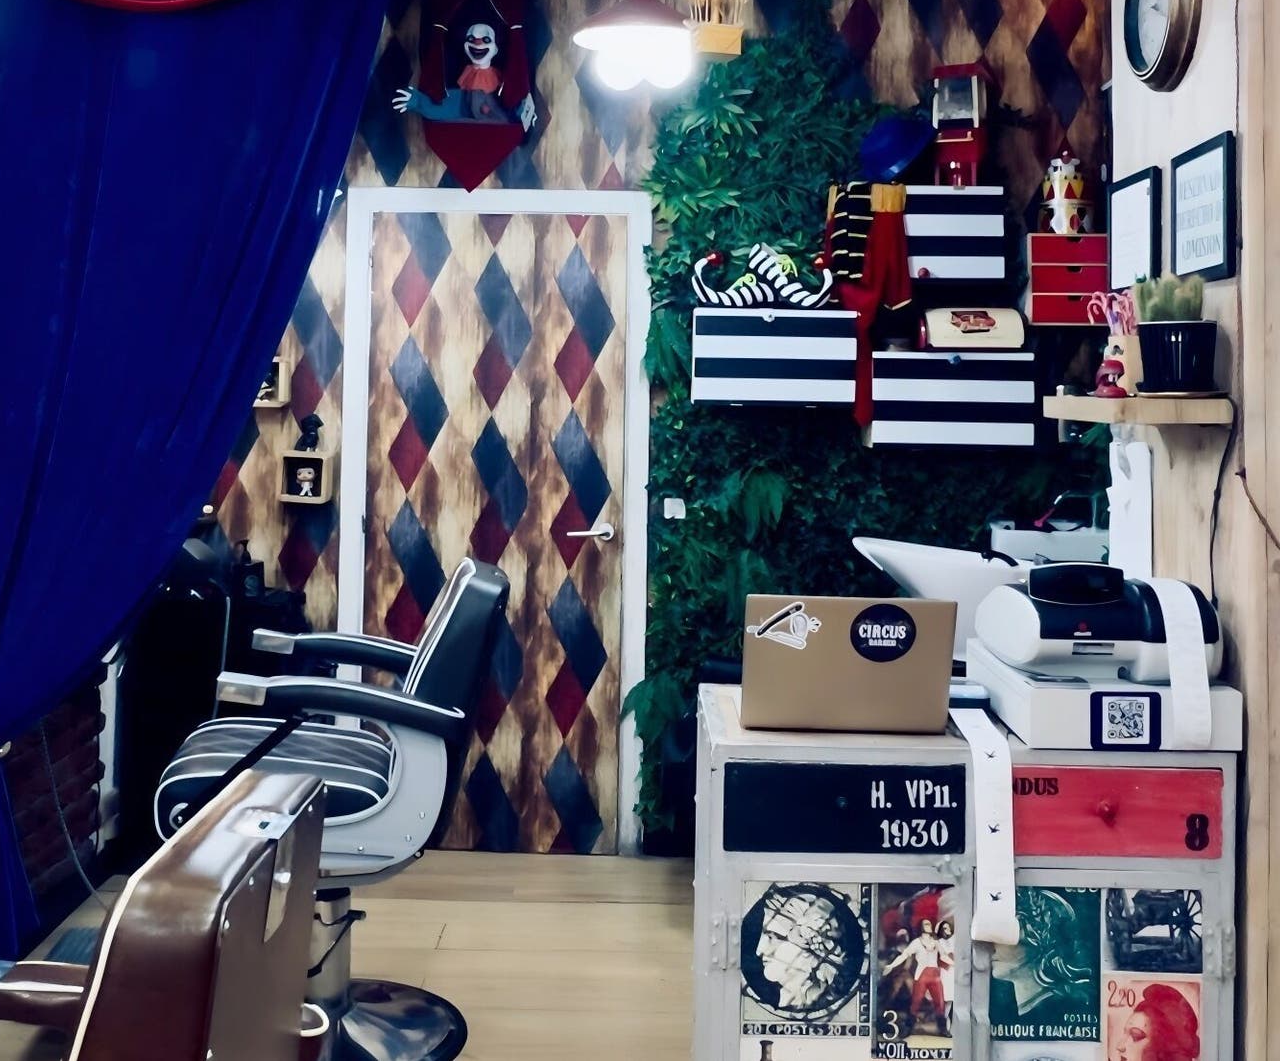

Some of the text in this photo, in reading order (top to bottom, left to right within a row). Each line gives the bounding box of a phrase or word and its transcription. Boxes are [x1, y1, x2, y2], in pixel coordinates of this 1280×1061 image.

[858, 623, 907, 640] CIRCUS
[870, 780, 893, 809] H.
[879, 819, 949, 848] 1930
[1185, 813, 1210, 852] 8
[882, 1010, 900, 1040] 3
